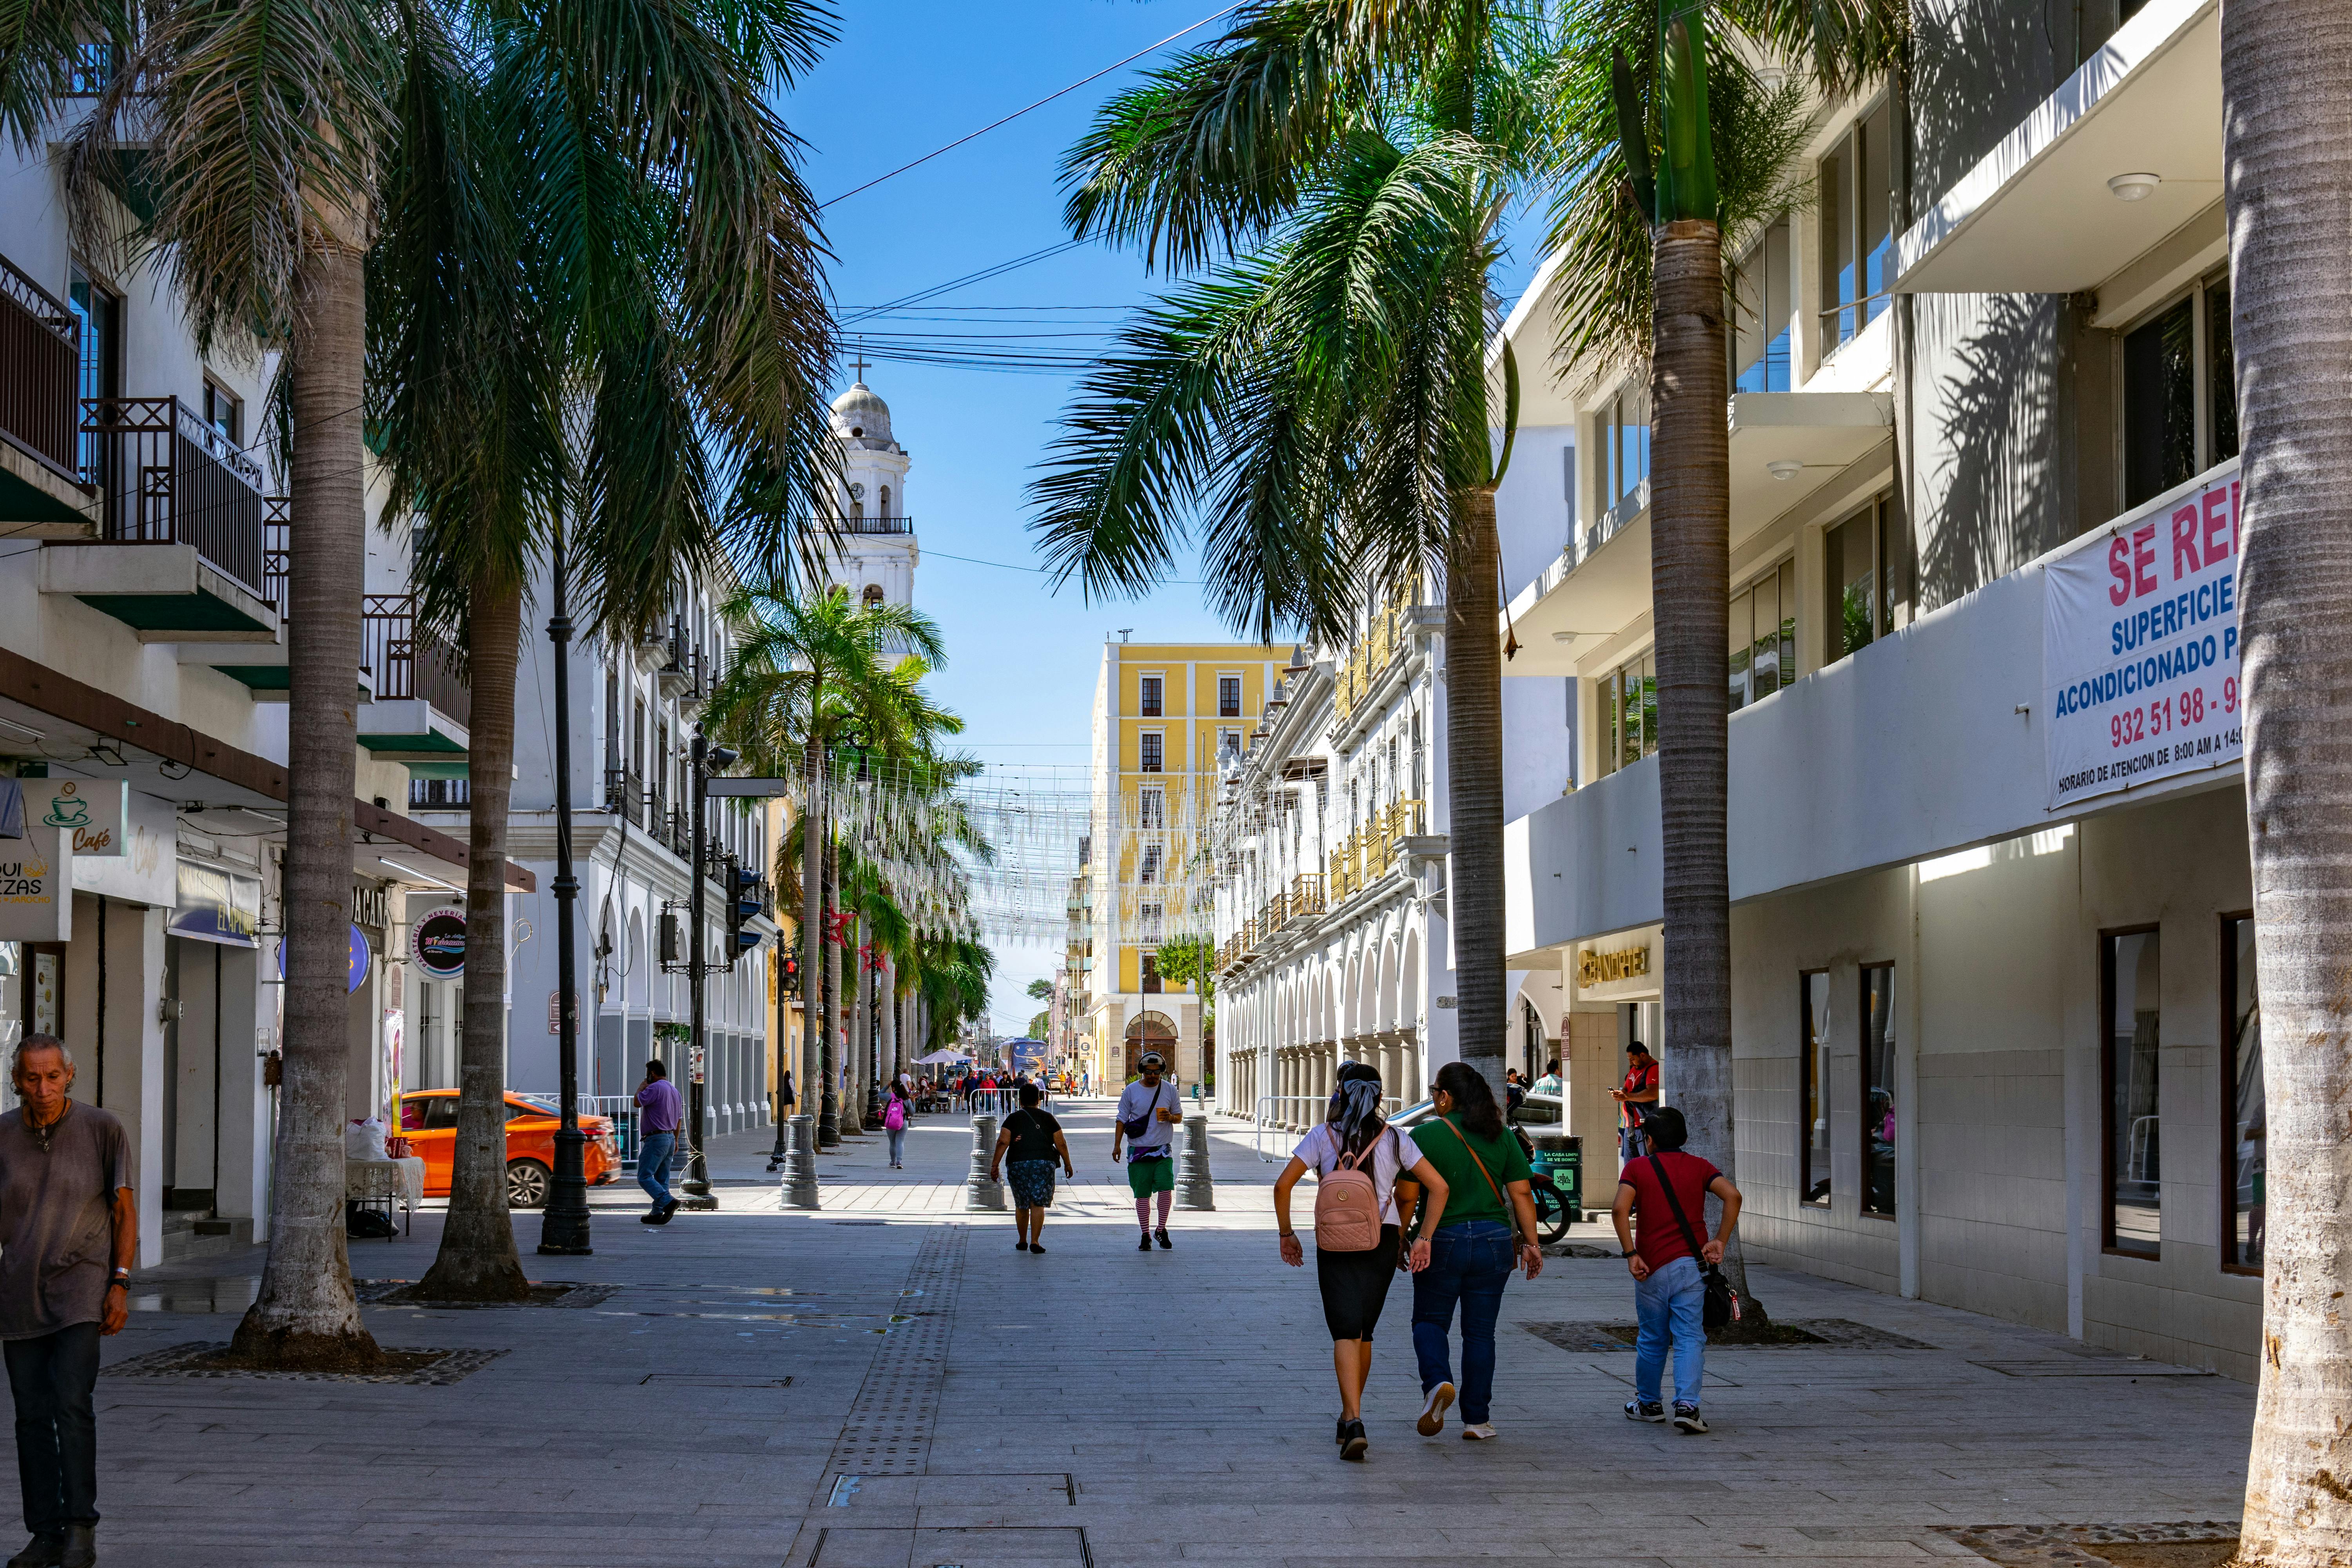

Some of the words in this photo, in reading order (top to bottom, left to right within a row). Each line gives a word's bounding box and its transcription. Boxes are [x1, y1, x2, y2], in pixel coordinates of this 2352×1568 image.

[2109, 523, 2157, 606] SE
[2112, 574, 2233, 655] SUPERFICIE
[2056, 635, 2216, 719] ACONDICIONADO
[2224, 626, 2239, 660] P
[2111, 707, 2144, 748] 932
[2151, 697, 2171, 735] 51
[2180, 688, 2204, 726] 98
[2059, 769, 2095, 794] HORARIO
[2098, 765, 2108, 782] DE
[2111, 751, 2154, 779] ATENCION
[2158, 748, 2169, 766] DE
[2174, 741, 2194, 761] 8:00
[2197, 737, 2211, 755] AM
[2214, 734, 2221, 752] A
[73, 827, 111, 851] Café
[135, 825, 158, 879] Café
[0, 862, 21, 878] UI
[0, 880, 42, 895] ZAS
[178, 866, 226, 902] SANITARIOS
[217, 904, 227, 931] EL
[228, 906, 255, 935] APURO
[352, 886, 389, 930] ACANA
[412, 924, 427, 968] PALETERÍA
[428, 910, 463, 920] NEVERÍA
[1590, 947, 1646, 983] BANORTE
